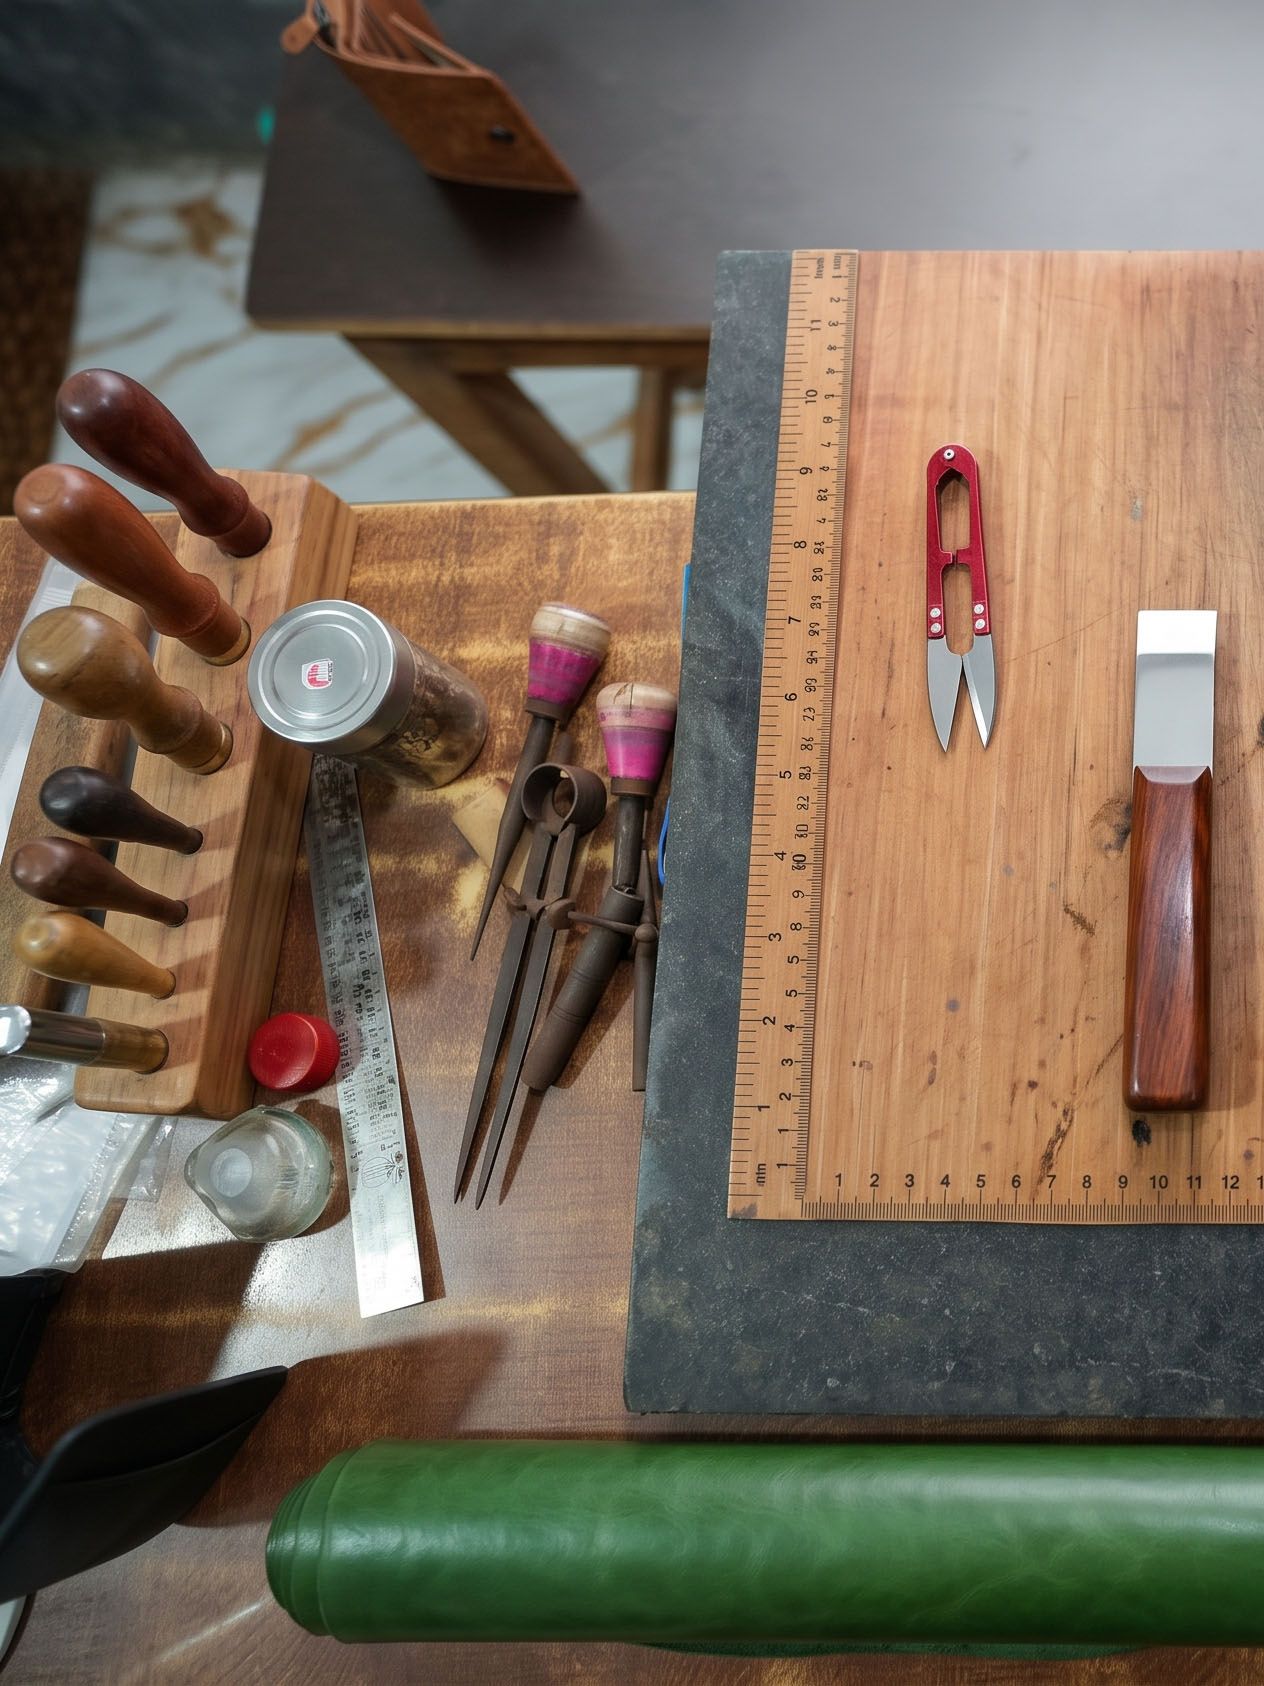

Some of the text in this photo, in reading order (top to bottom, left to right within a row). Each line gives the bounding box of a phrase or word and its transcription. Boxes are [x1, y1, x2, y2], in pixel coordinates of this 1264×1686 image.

[757, 319, 822, 1113] 1 2 3 4 5 6 7 8 9 10 11
[791, 889, 805, 899] 9
[789, 921, 803, 932] 8
[787, 955, 800, 965] 5
[785, 989, 798, 999] 5
[783, 1023, 796, 1033] 4
[781, 1058, 794, 1067] 3
[778, 1092, 792, 1102] 2
[834, 1172, 842, 1187] 1
[869, 1173, 880, 1188] 2
[904, 1173, 915, 1188] 3
[939, 1173, 951, 1188] 4
[976, 1173, 986, 1189] 5
[1011, 1174, 1022, 1189] 6
[1045, 1174, 1057, 1189] 7
[1082, 1174, 1092, 1189] 8
[1118, 1174, 1129, 1190] 9
[1149, 1174, 1169, 1190] 10
[1186, 1174, 1202, 1190] 11
[1221, 1175, 1240, 1190] 12
